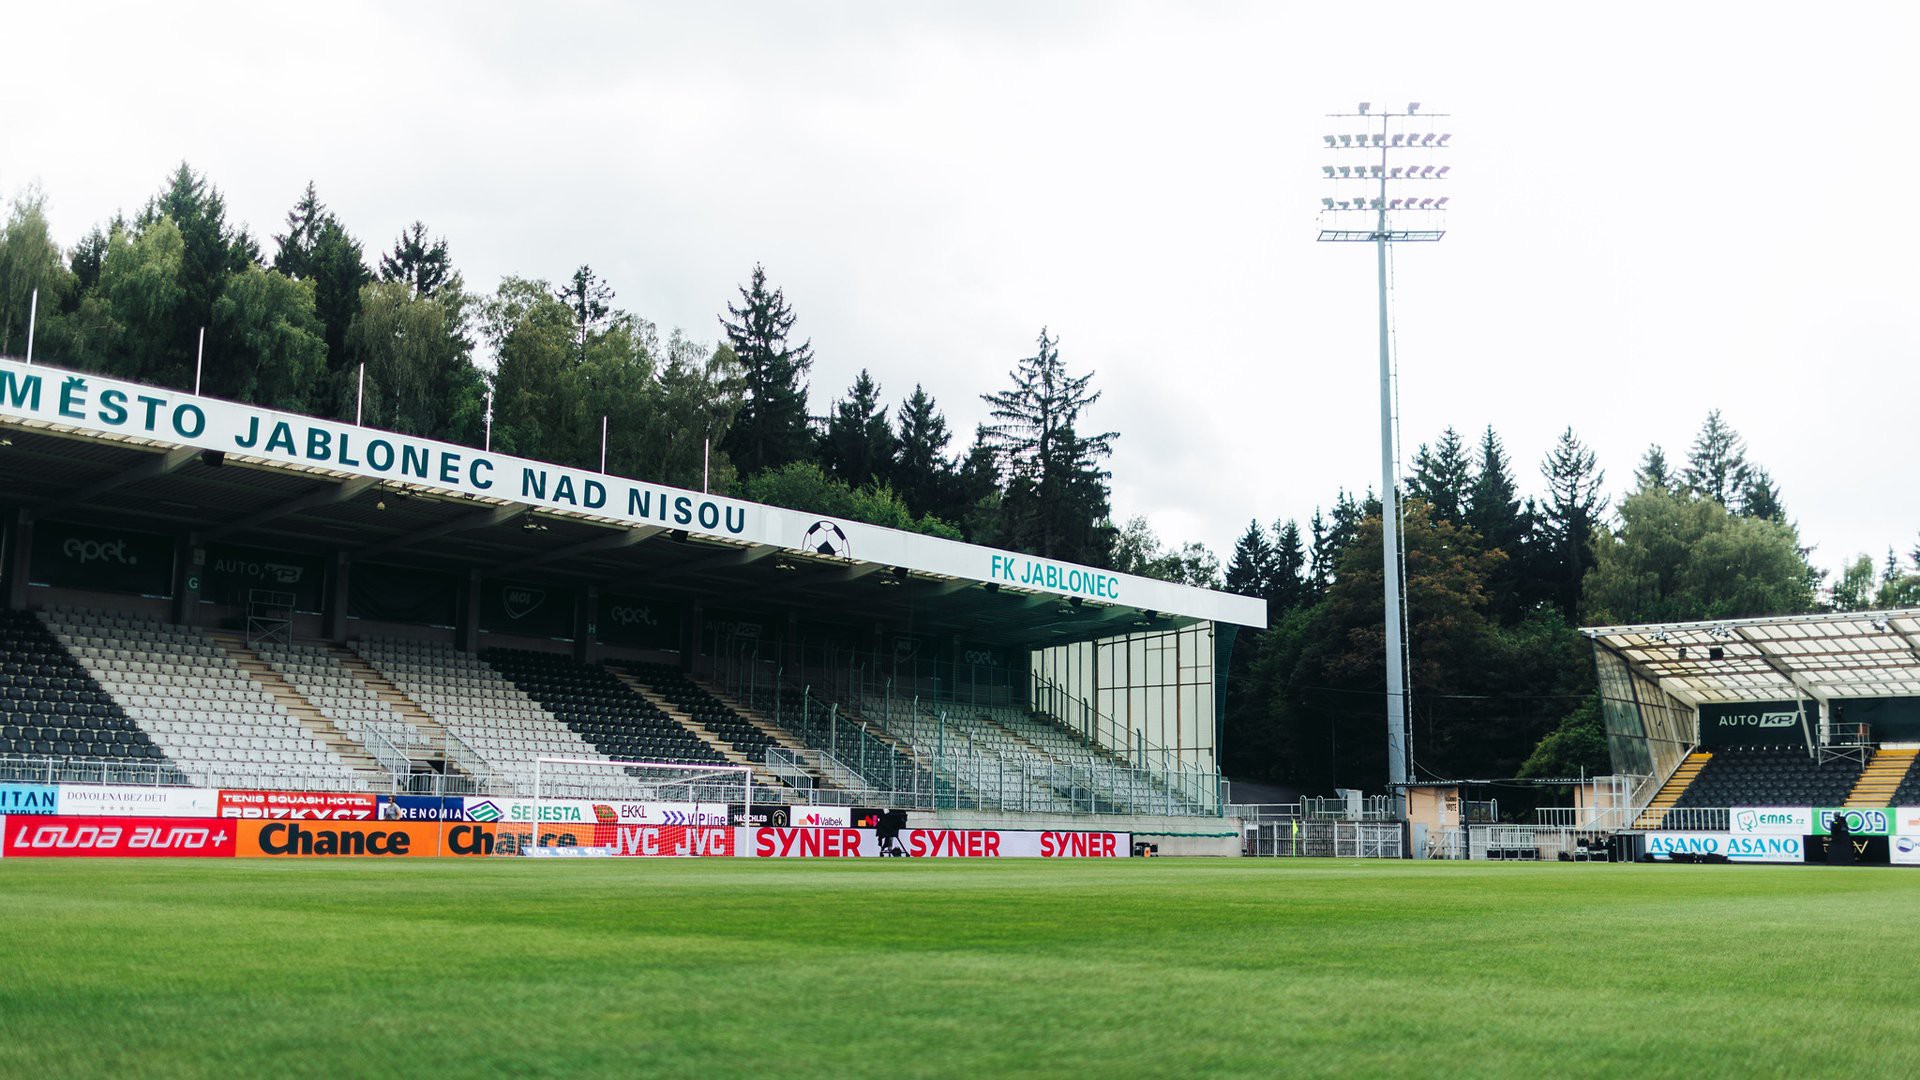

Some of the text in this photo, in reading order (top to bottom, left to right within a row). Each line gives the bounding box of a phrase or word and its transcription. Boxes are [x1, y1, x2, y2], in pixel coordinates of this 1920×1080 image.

[0, 370, 745, 534] MĚSTO JABLONEC NAD NISOU
[214, 559, 260, 576] AUTO
[188, 577, 199, 589] G
[991, 555, 1119, 599] FK JABLONEC
[588, 624, 596, 634] H
[1718, 714, 1759, 726] AUTO
[222, 794, 372, 806] TENIS SQUASH HOTEL
[400, 807, 462, 820] RENOMIA
[819, 816, 843, 827] Valbek
[259, 822, 411, 855] Chance
[604, 828, 660, 855] JVC
[675, 828, 726, 855] JVC
[756, 826, 861, 857] SYNER
[909, 828, 1000, 857] SYNER
[1040, 831, 1117, 857] SYNER
[1650, 837, 1719, 853] ASANO
[1727, 838, 1799, 854] ASANO
